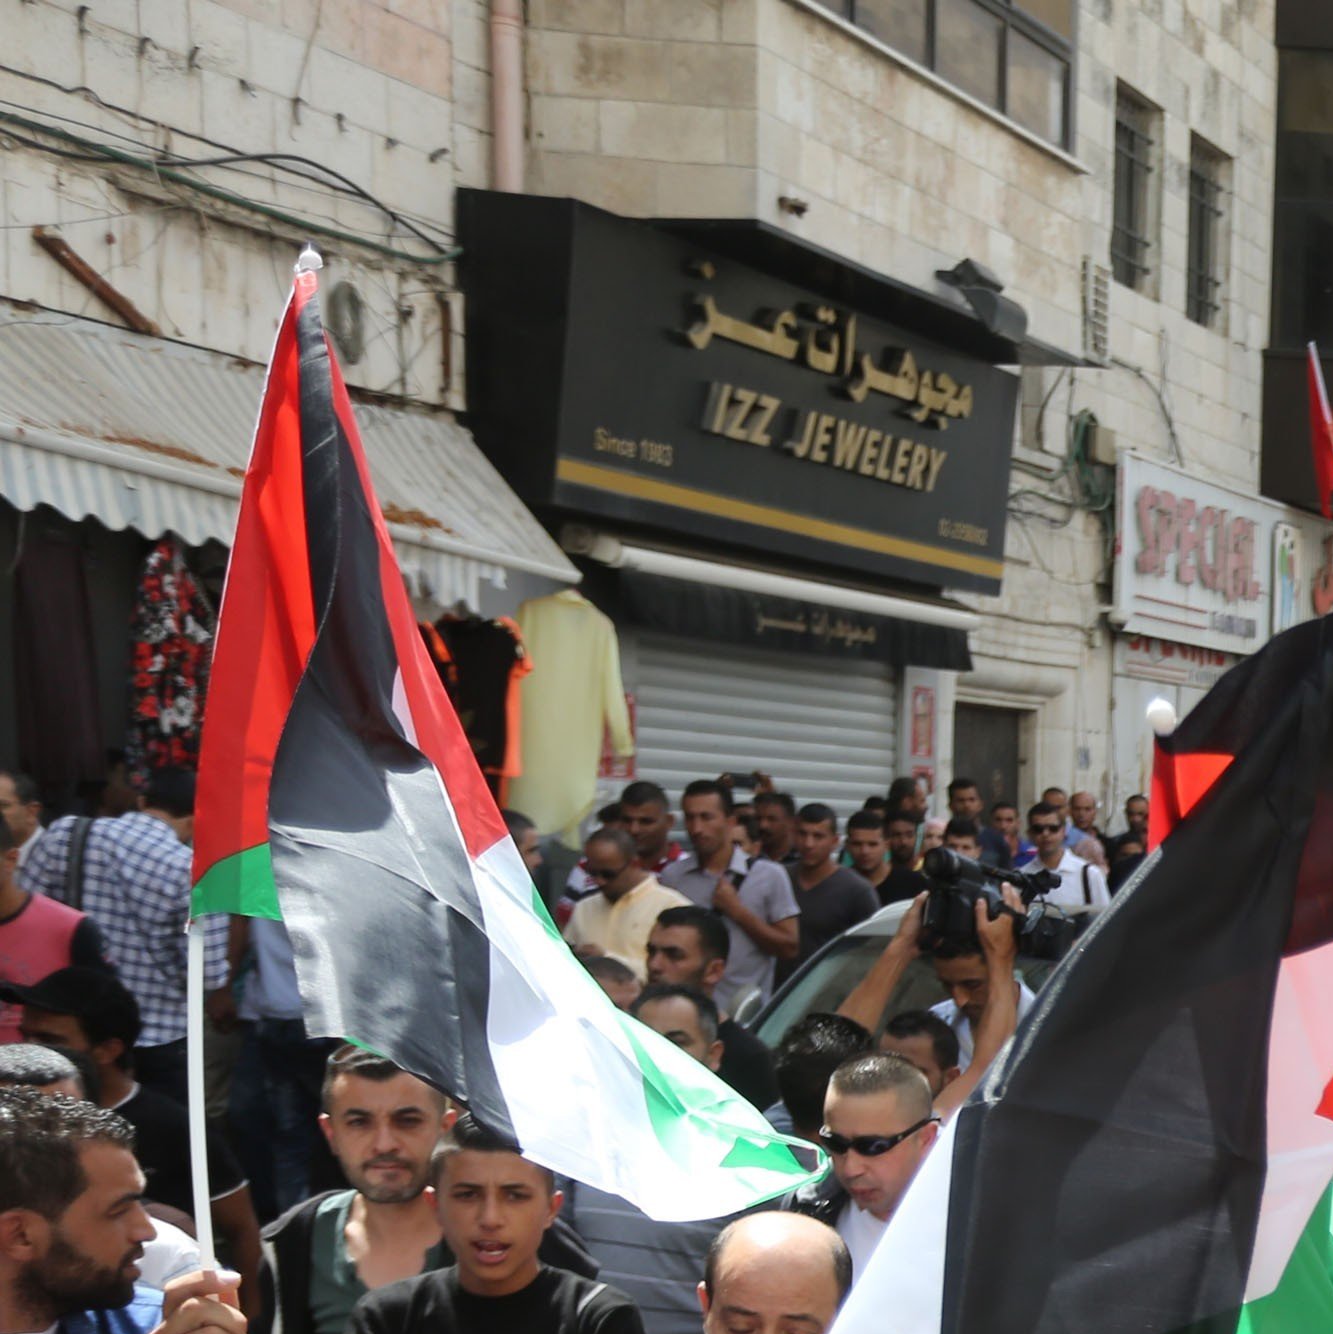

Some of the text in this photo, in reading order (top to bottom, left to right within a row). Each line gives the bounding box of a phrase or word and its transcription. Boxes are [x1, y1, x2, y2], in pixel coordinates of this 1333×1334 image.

[687, 261, 974, 431] مجوهرات عز
[593, 426, 638, 458] Since
[709, 382, 950, 494] IZZ JEWELERY
[1134, 484, 1261, 604] SPECIAL
